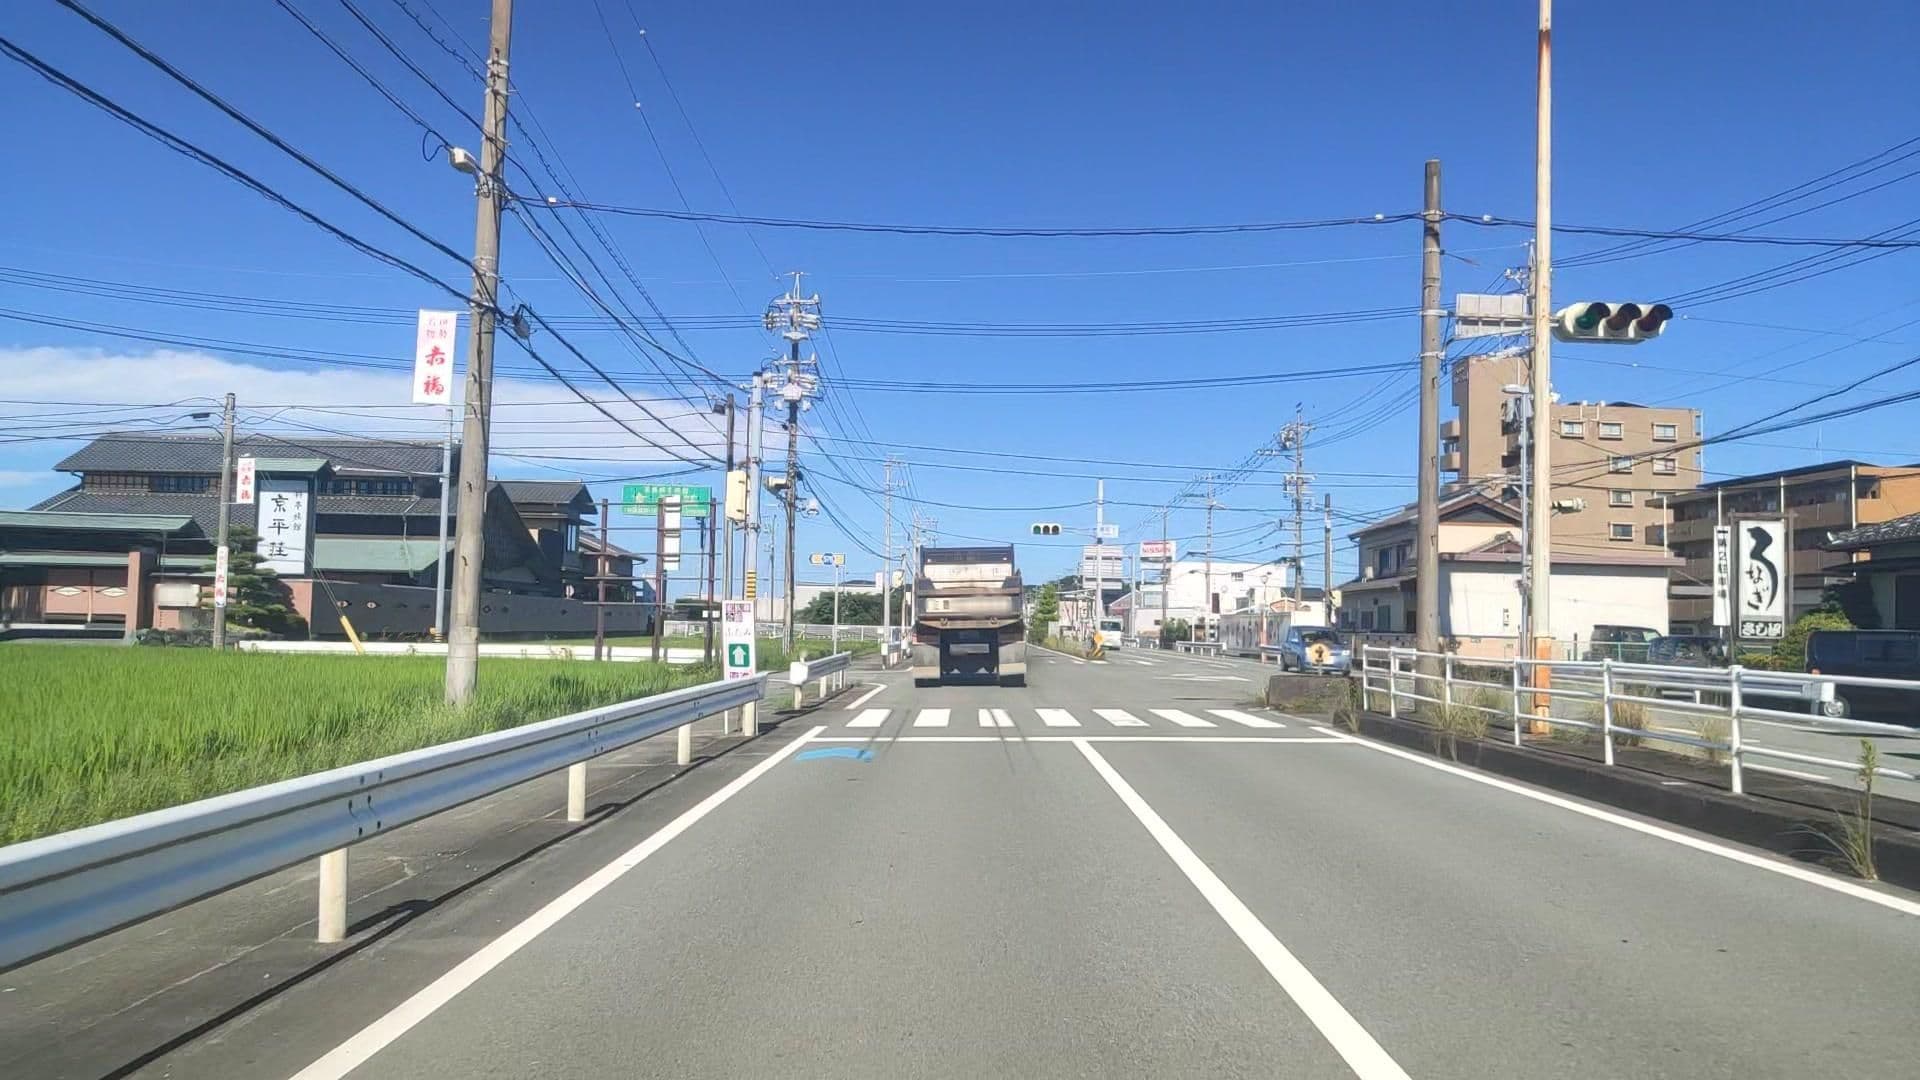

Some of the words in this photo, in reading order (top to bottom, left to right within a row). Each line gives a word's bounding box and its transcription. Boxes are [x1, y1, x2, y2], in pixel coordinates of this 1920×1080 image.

[268, 494, 289, 557] 京平荘
[1745, 526, 1778, 610] うなぎ
